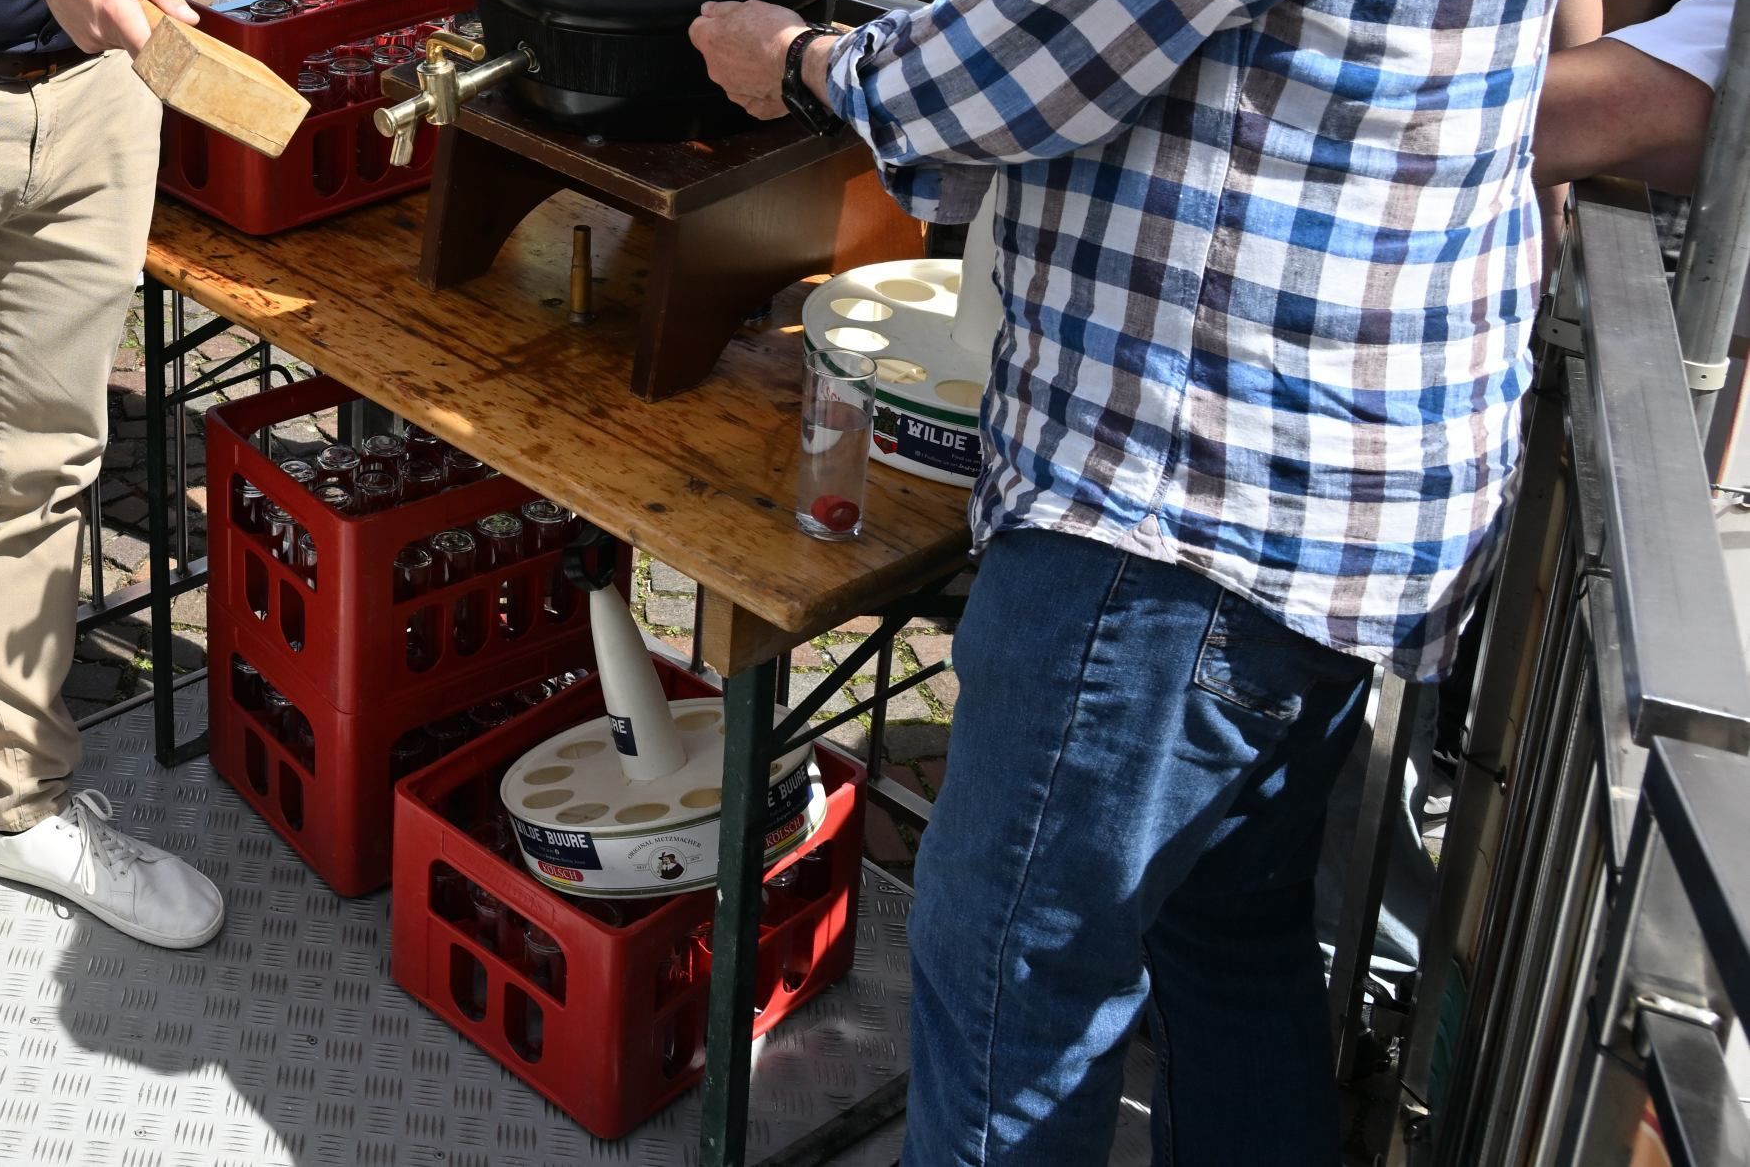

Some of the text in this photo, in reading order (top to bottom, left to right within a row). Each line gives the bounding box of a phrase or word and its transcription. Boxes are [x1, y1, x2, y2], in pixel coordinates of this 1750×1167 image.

[906, 418, 968, 452] WILDE
[778, 764, 808, 800] BUURE
[544, 830, 590, 849] BUURE
[627, 835, 702, 860] ORIGINAL METZMACHER
